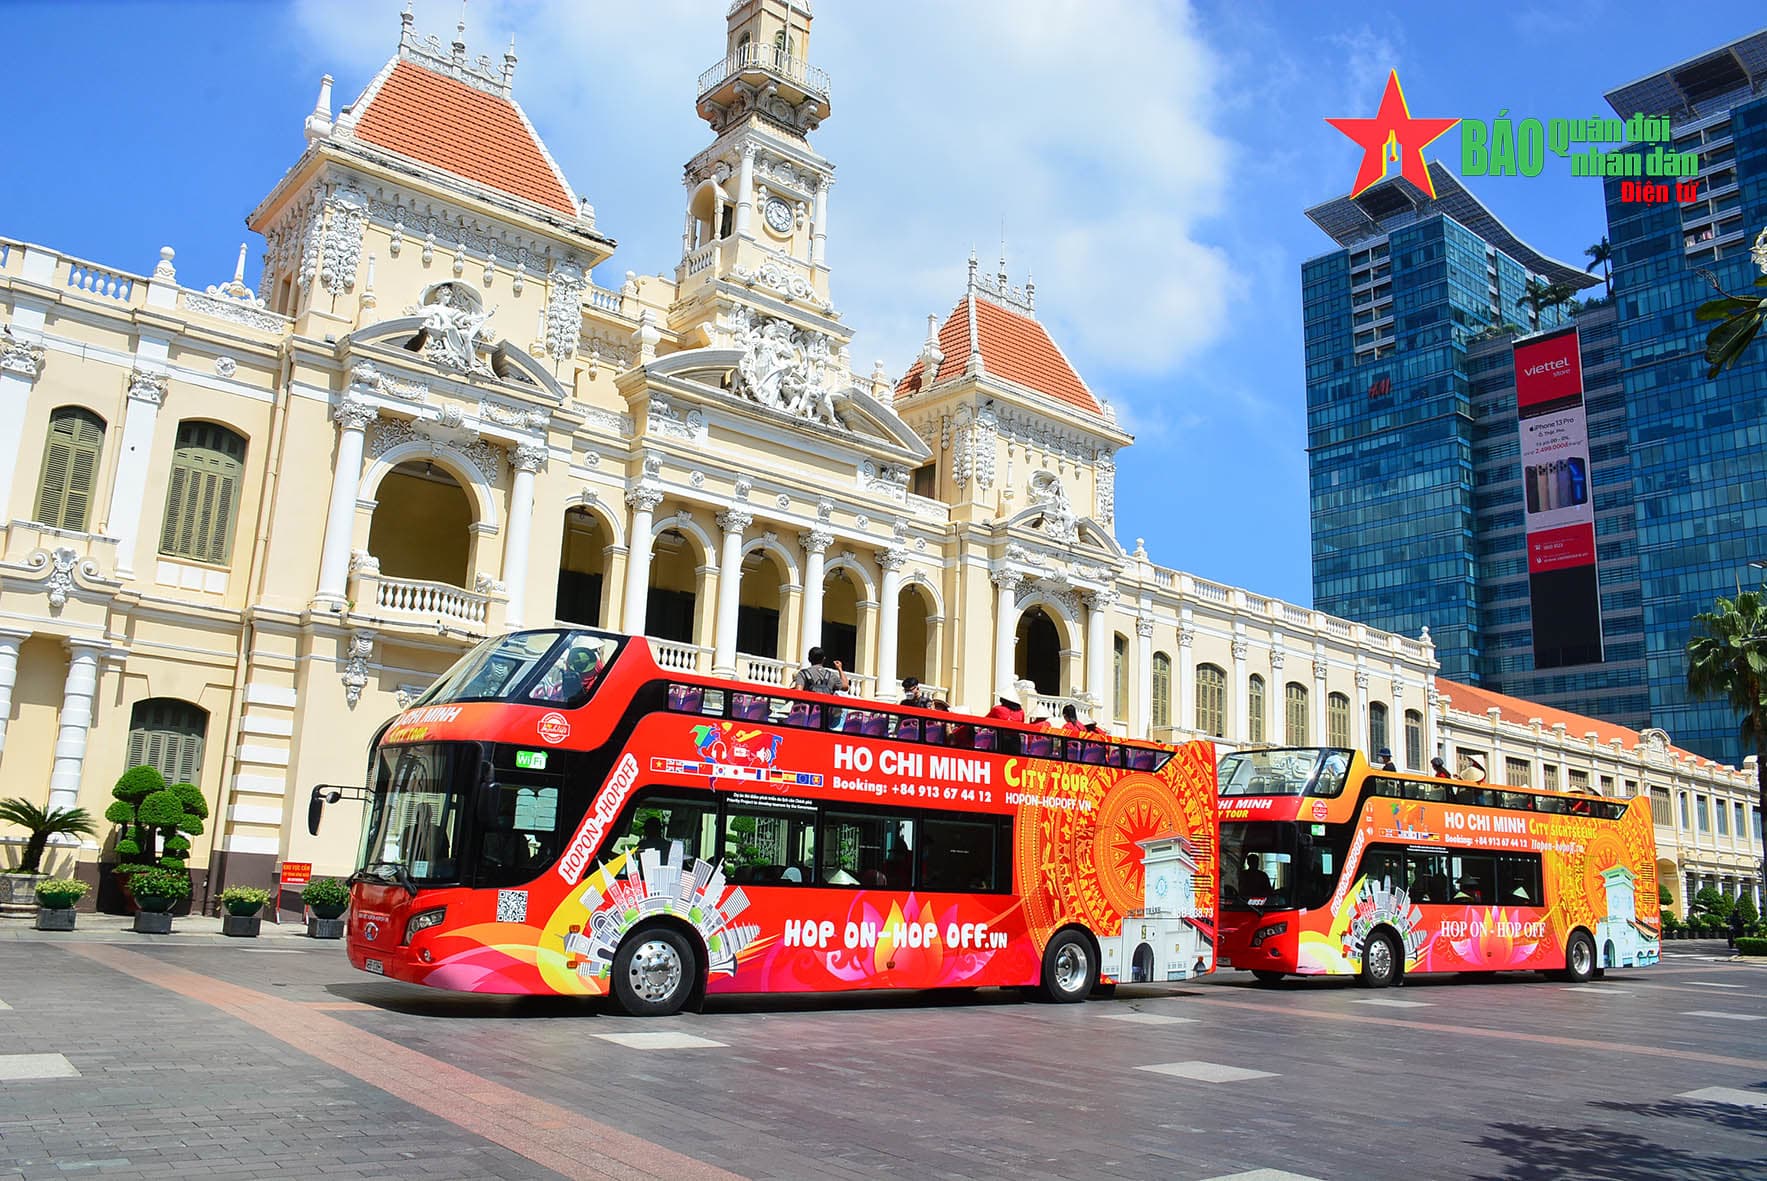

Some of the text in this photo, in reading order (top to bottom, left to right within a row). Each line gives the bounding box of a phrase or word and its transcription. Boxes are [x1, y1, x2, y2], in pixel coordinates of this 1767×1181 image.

[1524, 357, 1569, 376] viettel
[1553, 368, 1571, 377] store
[1533, 417, 1575, 432] iPhone 13 Pro
[424, 706, 463, 723] MINH
[834, 743, 991, 785] HO CHI MINH
[833, 776, 992, 803] Booking: +84 913 67 44 12
[1051, 771, 1089, 793] TOUR
[1235, 799, 1273, 809] MINH
[1225, 809, 1249, 819] TOUR
[1444, 811, 1464, 830] HO
[1467, 814, 1491, 832] CHI
[1493, 816, 1526, 834] MINH
[1444, 833, 1473, 847] Booking:
[1474, 836, 1487, 846] +84
[1488, 837, 1501, 847] 913
[1501, 838, 1510, 847] 67
[1511, 838, 1519, 848] 44
[1520, 839, 1528, 848] 12
[784, 919, 835, 948] HOP
[1441, 920, 1468, 938] HOP
[1470, 921, 1488, 938] ON
[1497, 921, 1522, 938] HOP
[1524, 922, 1546, 938] OFF
